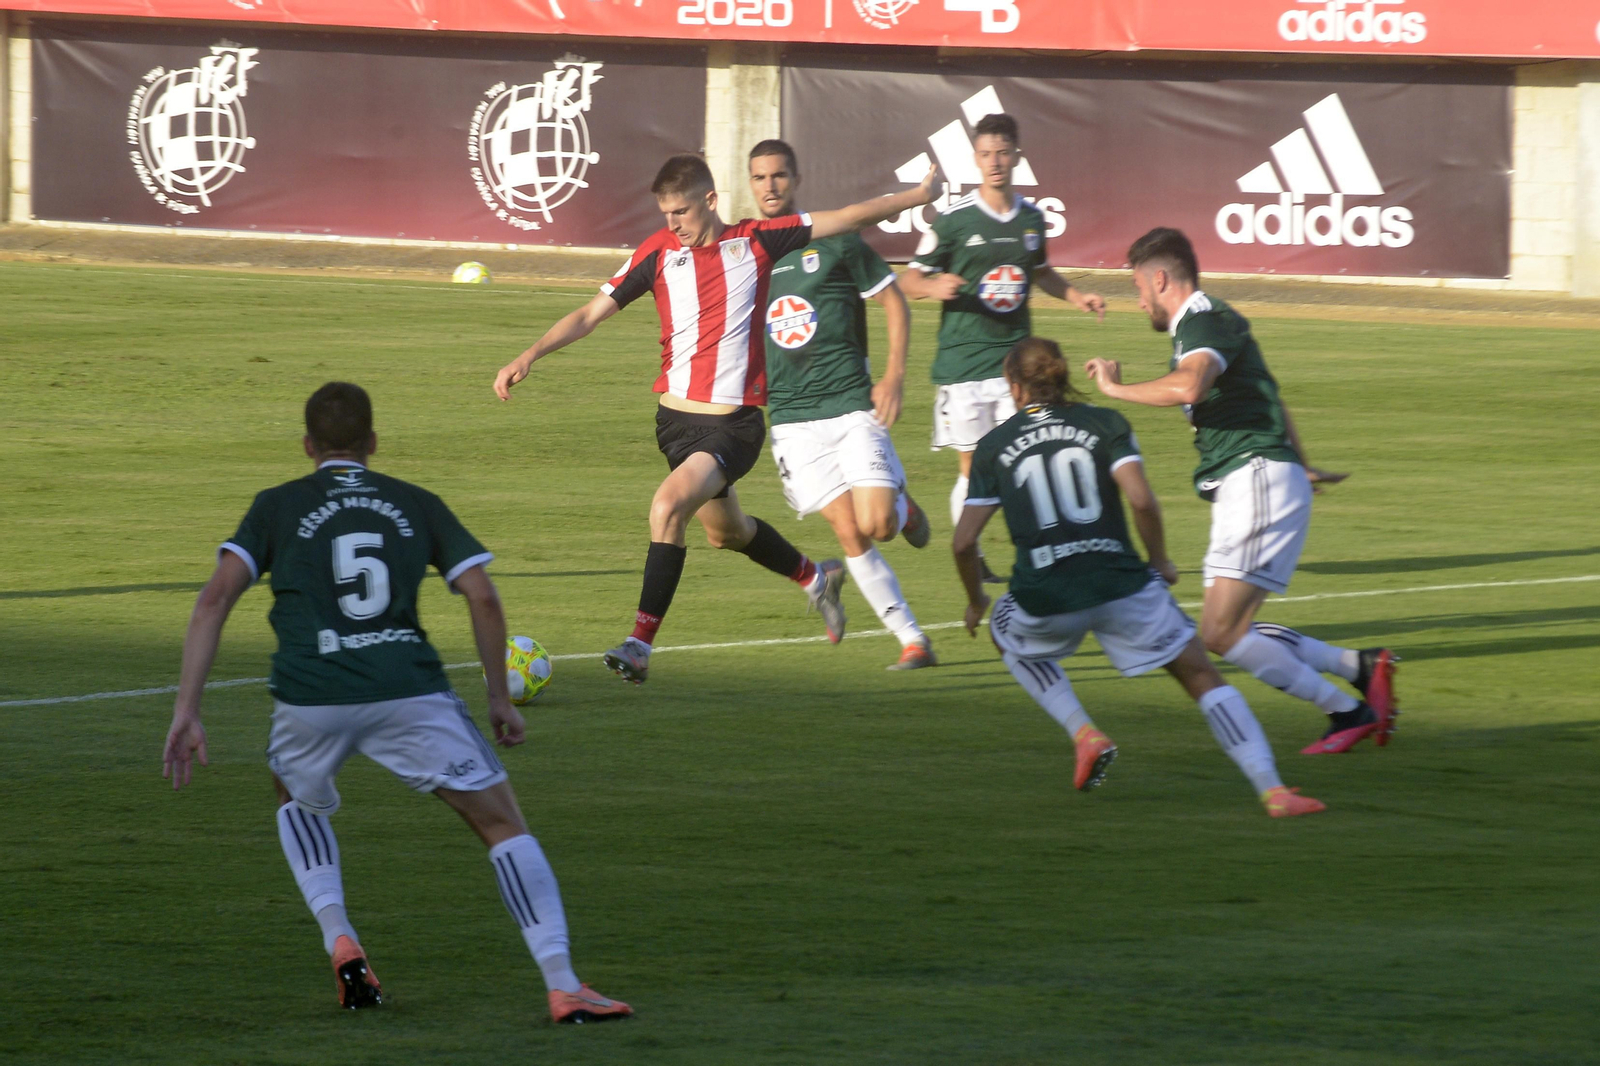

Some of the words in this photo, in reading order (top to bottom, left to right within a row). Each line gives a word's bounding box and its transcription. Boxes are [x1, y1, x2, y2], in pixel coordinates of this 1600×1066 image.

[677, 0, 793, 27] 2020
[1277, 2, 1427, 43] adidas
[1215, 191, 1414, 248] adidas
[998, 425, 1100, 468] ALEXANDRE
[1012, 446, 1103, 530] 10
[331, 532, 390, 620] 5
